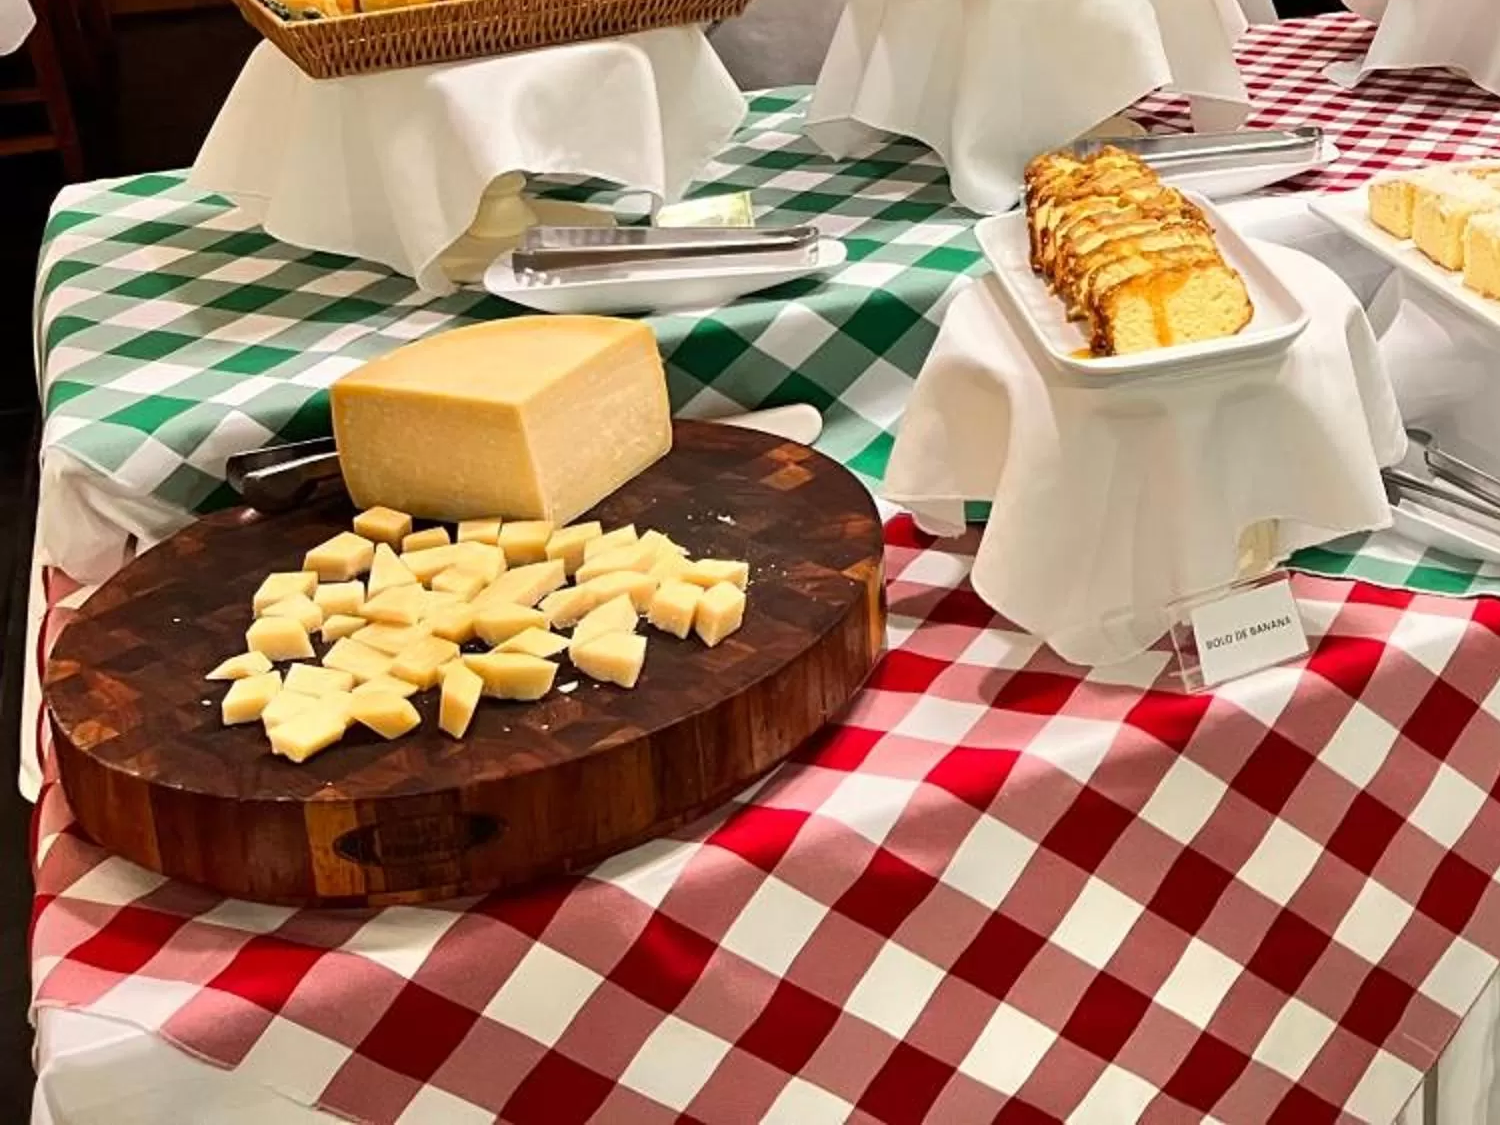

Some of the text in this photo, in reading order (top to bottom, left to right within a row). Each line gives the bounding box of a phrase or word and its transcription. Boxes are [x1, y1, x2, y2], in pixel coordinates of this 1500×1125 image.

[1206, 615, 1291, 650] BOLO DE BANANA
